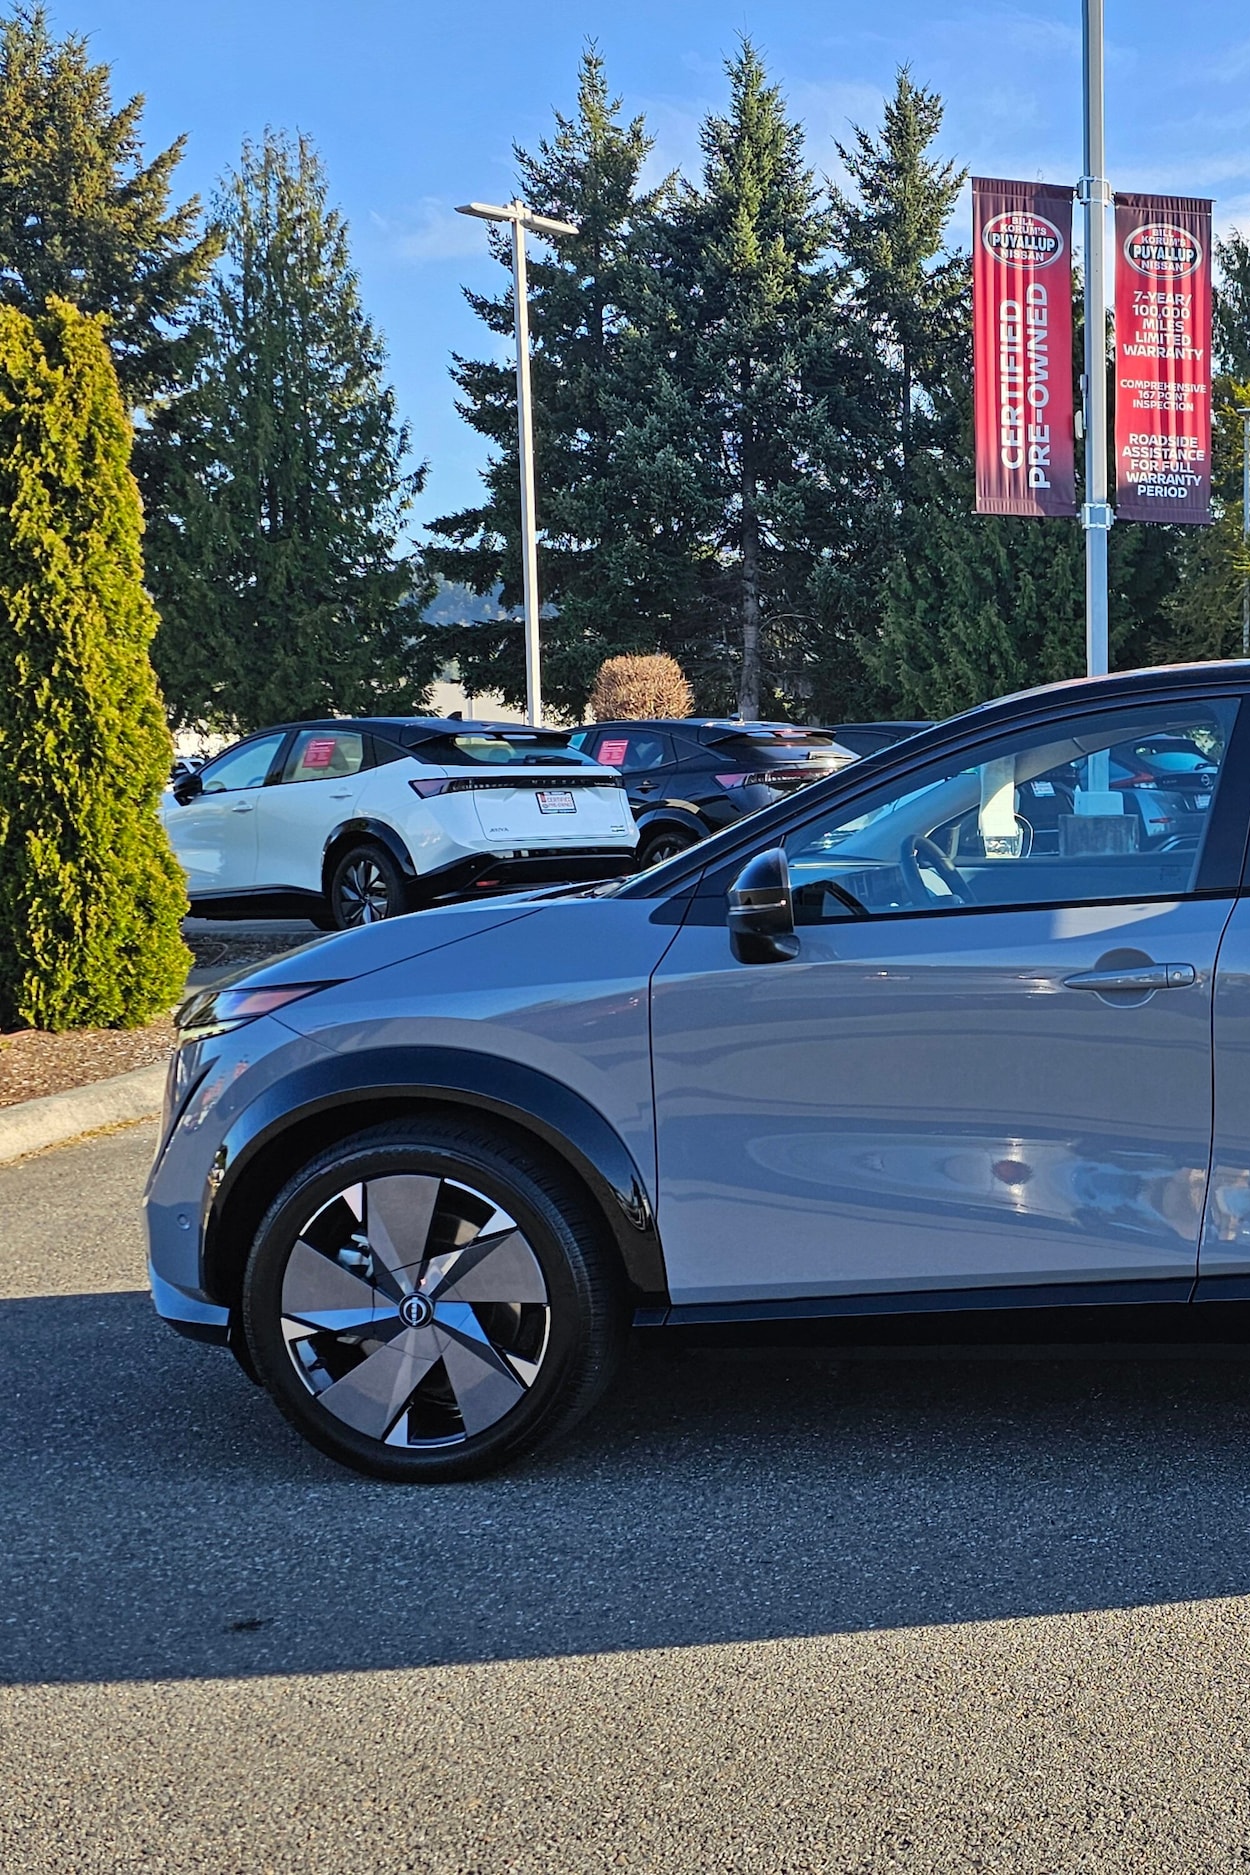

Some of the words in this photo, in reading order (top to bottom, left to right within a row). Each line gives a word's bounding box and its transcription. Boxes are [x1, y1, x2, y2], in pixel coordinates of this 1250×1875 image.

[1012, 216, 1034, 226] BILL
[1000, 223, 1047, 236] KORUM'S
[1152, 228, 1174, 237] BILL
[992, 233, 1056, 252] PUYALLUP
[1141, 235, 1187, 248] KORUM'S
[1001, 249, 1045, 262] NISSAN
[1133, 244, 1195, 263] PUYALLUP
[1141, 260, 1184, 272] NISSAN
[1133, 290, 1192, 307] 7-YEAR/
[1132, 304, 1191, 320] 100,000
[1142, 318, 1185, 332] MILES
[1135, 331, 1192, 347] LIMITED
[1123, 343, 1204, 361] WARRANTY
[1000, 299, 1025, 470] CERTIFIED
[1026, 282, 1051, 489] PRE-OWNED
[1120, 379, 1207, 394] COMPREHENSIVE
[1138, 390, 1156, 400] 167
[1157, 391, 1190, 402] POINT
[1132, 399, 1194, 412] INSPECTION
[1129, 433, 1199, 449] ROADSIDE
[1122, 445, 1206, 462] ASSISTANCE
[1130, 459, 1159, 471] FOR
[1161, 461, 1195, 474] FULL
[1126, 470, 1203, 487] WARRANTY
[1137, 484, 1188, 499] PERIOD
